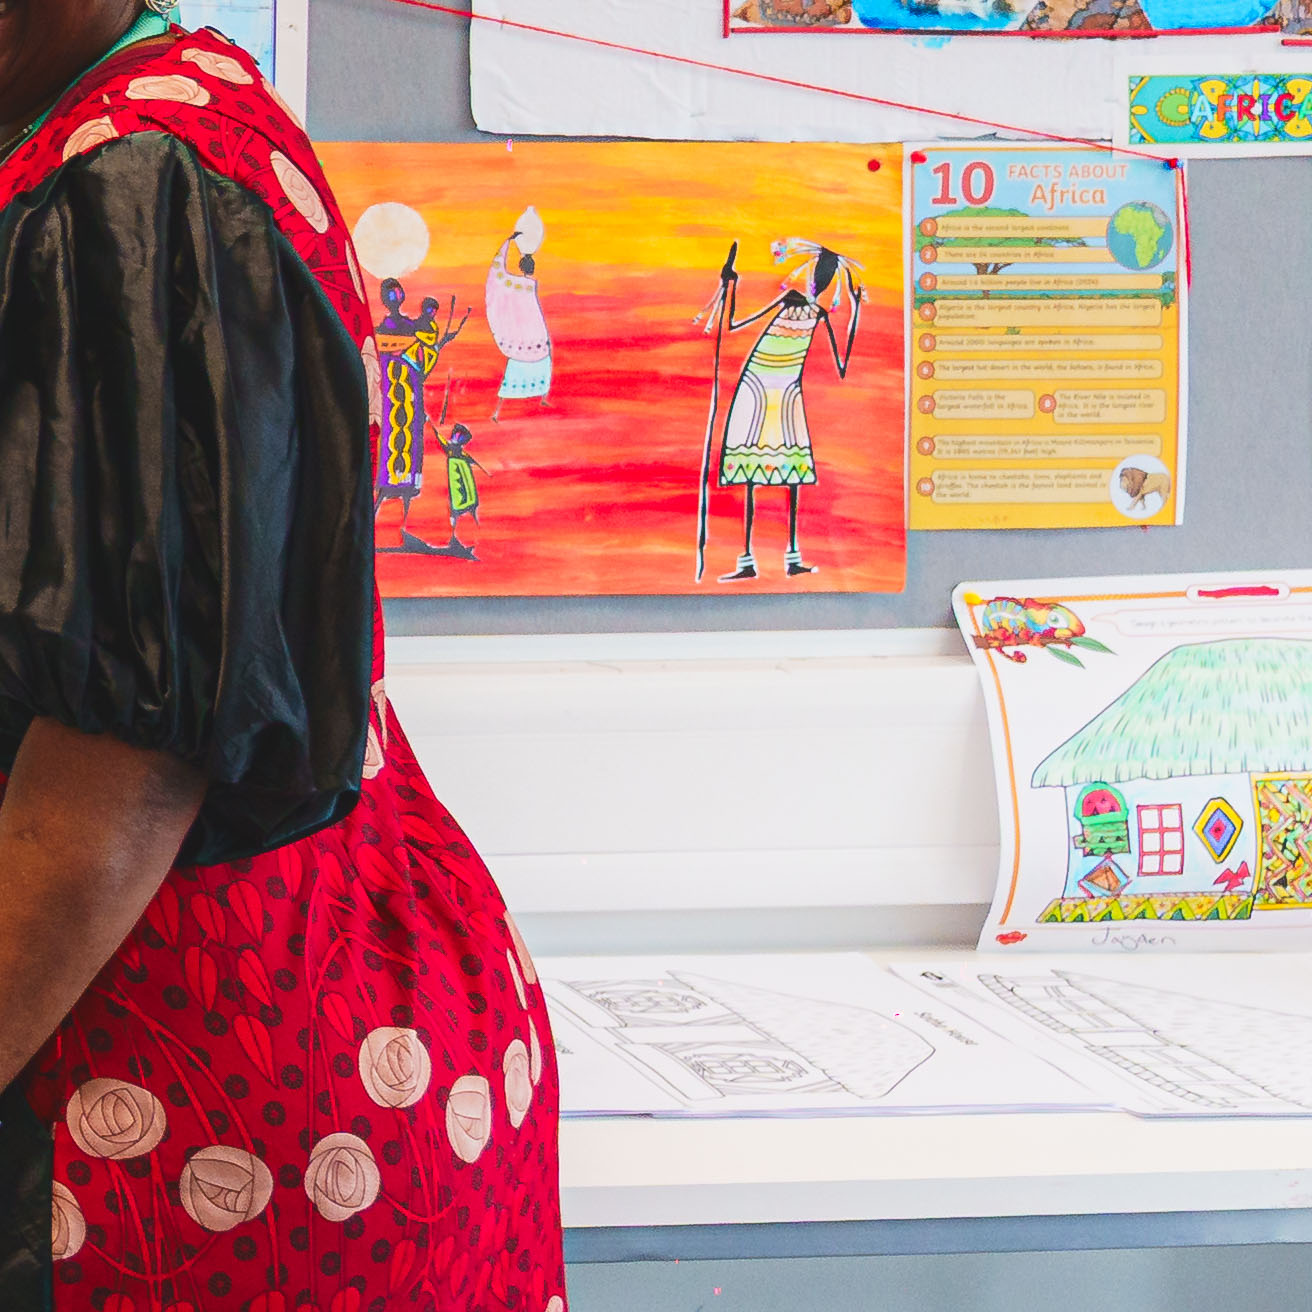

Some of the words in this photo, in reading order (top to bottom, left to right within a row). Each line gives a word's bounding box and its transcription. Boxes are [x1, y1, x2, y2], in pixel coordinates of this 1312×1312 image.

[1190, 93, 1312, 122] AFRICA
[931, 161, 995, 206] 10
[1008, 164, 1062, 179] FACTS
[1068, 164, 1128, 179] ABOUT
[1030, 182, 1106, 211] Africa
